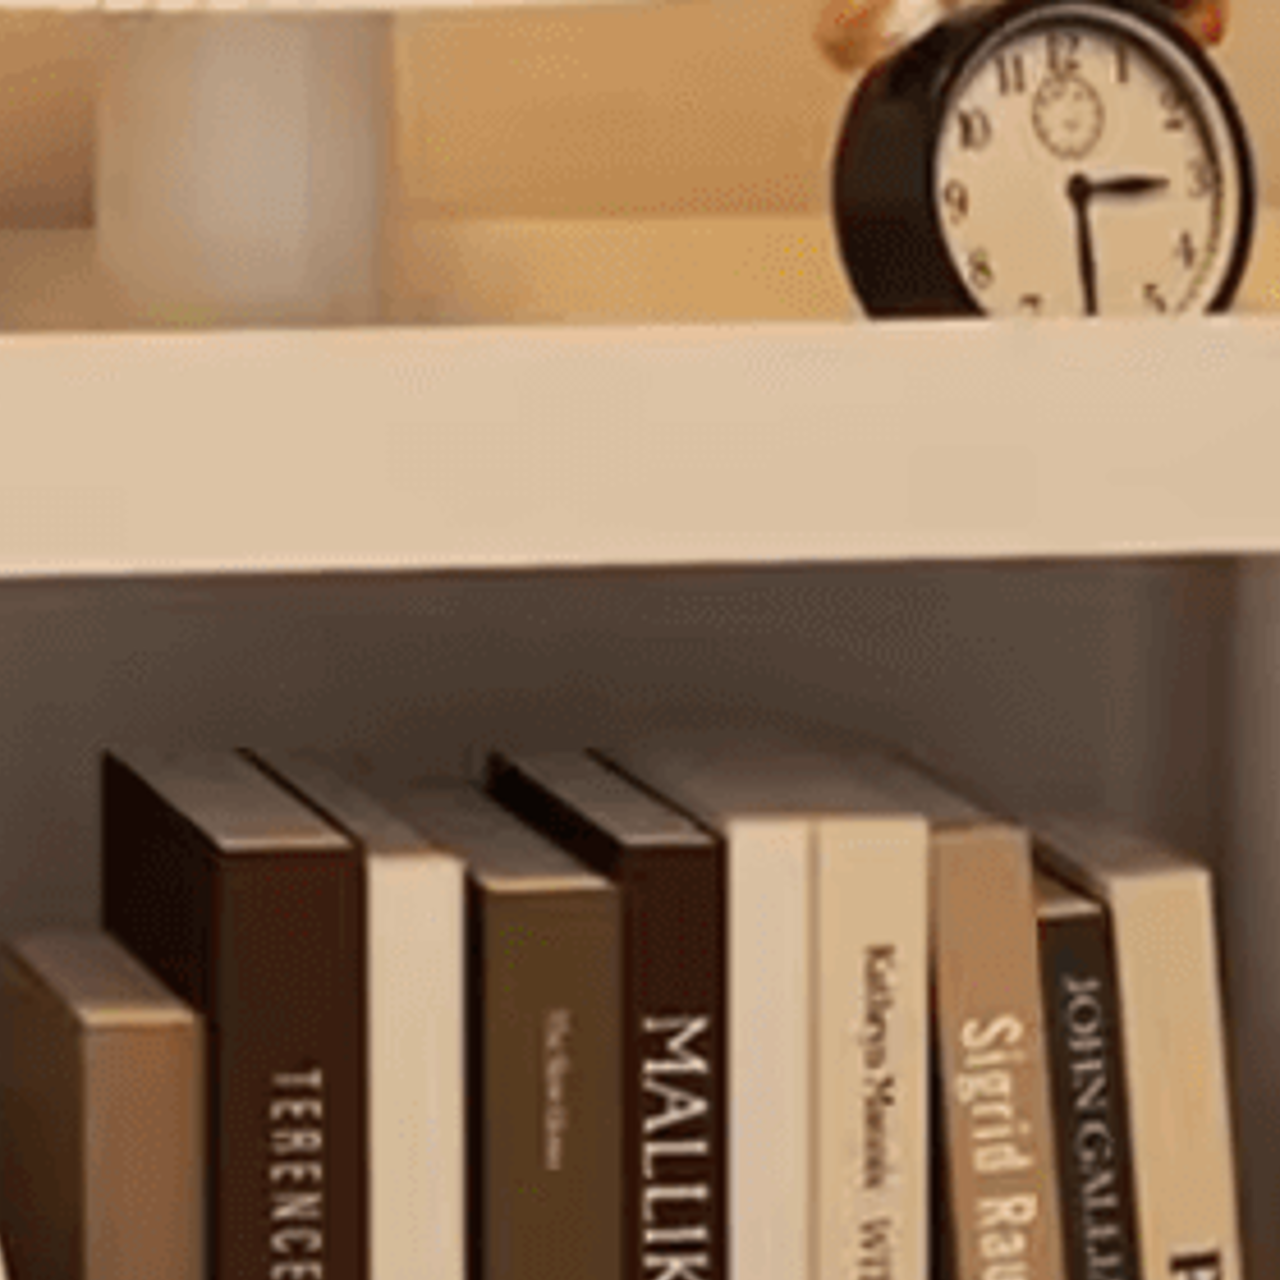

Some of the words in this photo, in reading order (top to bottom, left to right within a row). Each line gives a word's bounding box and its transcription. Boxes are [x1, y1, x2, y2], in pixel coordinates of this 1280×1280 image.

[995, 53, 1026, 95] 11
[1046, 34, 1081, 75] 12
[958, 108, 991, 150] 10
[943, 180, 969, 223] 9
[1061, 973, 1108, 1109] JOHN
[957, 1014, 1034, 1174] Sigrid
